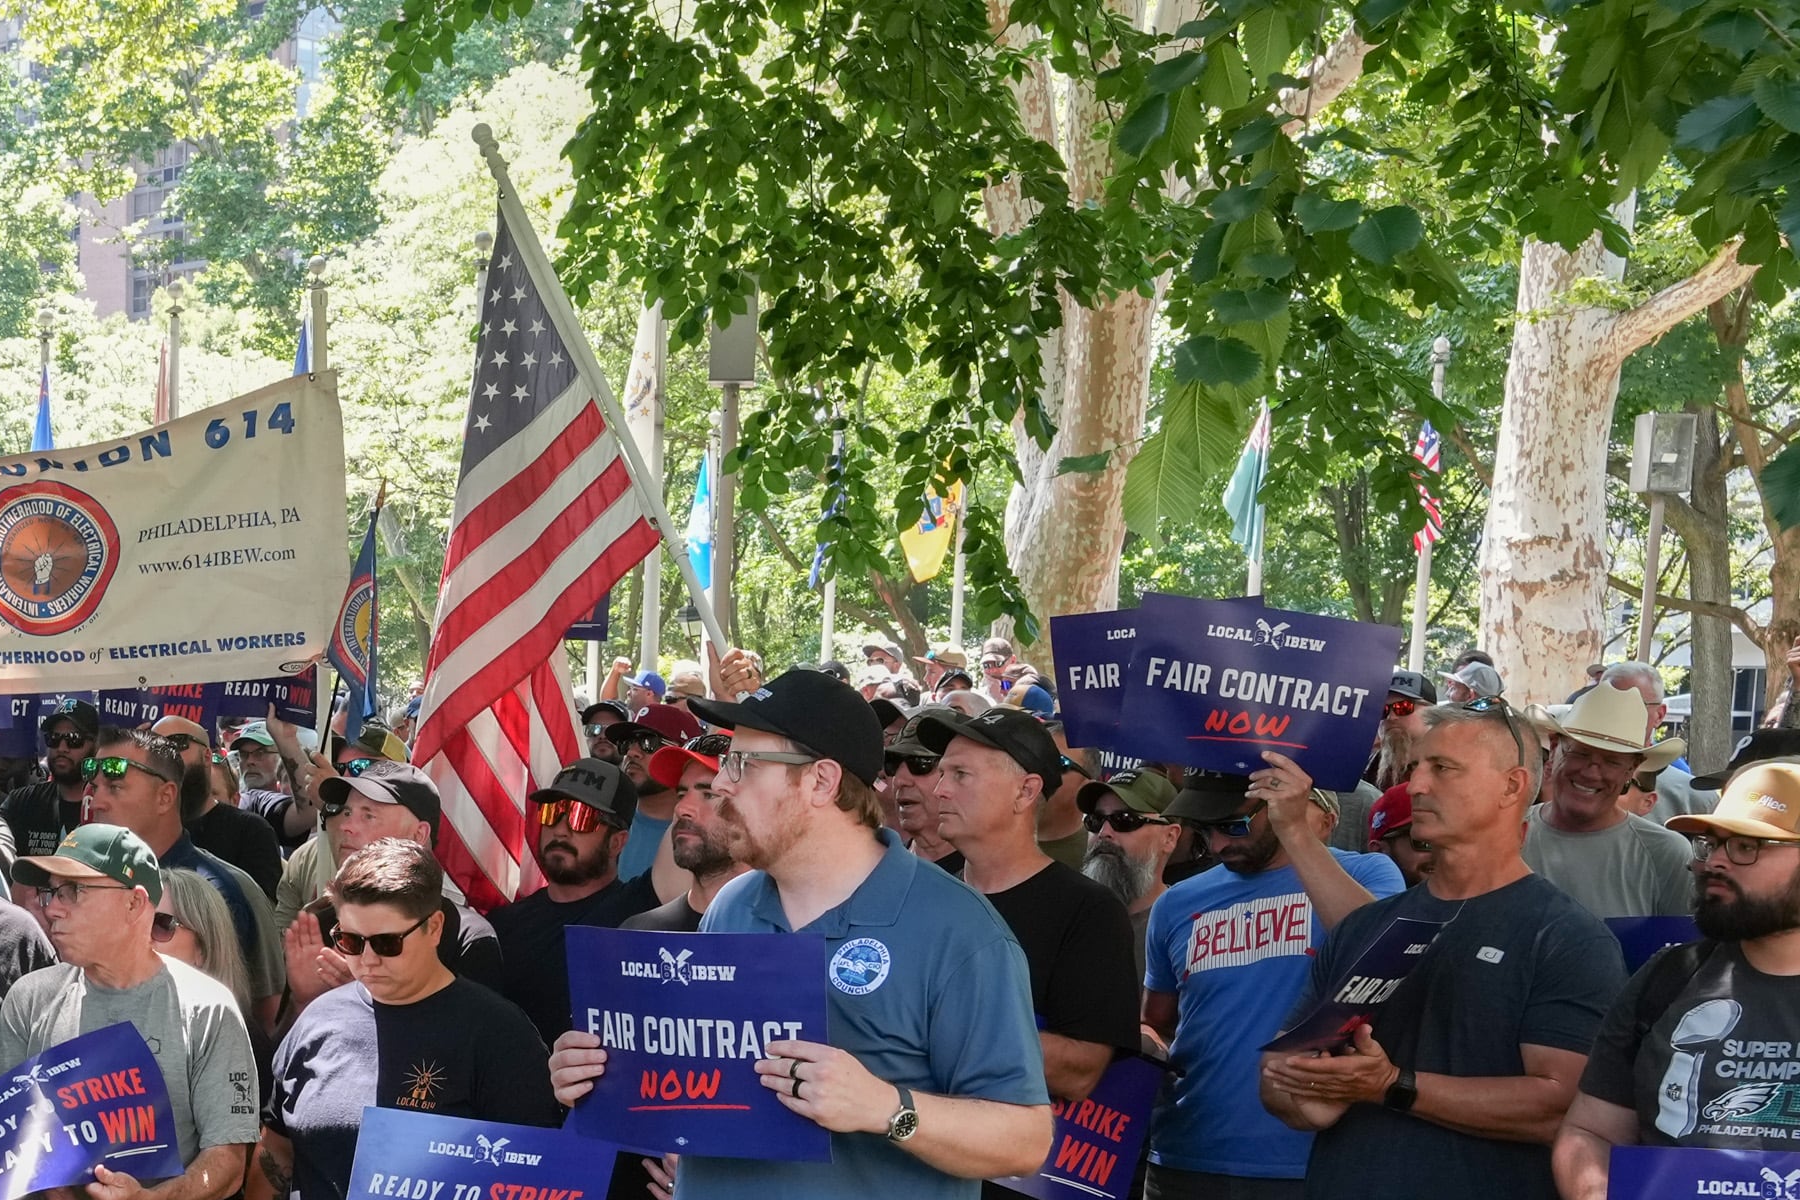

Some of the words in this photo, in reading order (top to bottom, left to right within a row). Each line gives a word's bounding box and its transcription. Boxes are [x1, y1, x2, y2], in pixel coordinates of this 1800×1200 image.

[204, 402, 295, 450] 614
[55, 503, 71, 519] OF
[137, 510, 276, 543] PHILADELPHIA,
[281, 506, 301, 524] PA
[70, 513, 101, 573] ELECTRICAL
[138, 547, 296, 575] www.614IBEW.com
[47, 575, 93, 615] WORKERS
[89, 647, 103, 665] of
[109, 640, 212, 660] ELECTRICAL
[217, 632, 306, 652] WORKERS
[1207, 624, 1254, 642] LOCAL
[1284, 637, 1326, 652] IBEW
[1069, 663, 1120, 690] FAIR
[1146, 656, 1212, 695] FAIR
[1219, 668, 1369, 719] CONTRACT
[224, 681, 271, 698] READY
[275, 684, 288, 700] TO
[289, 684, 312, 708] WIN
[105, 698, 137, 718] READY
[141, 705, 159, 721] TO
[163, 703, 204, 723] WIN
[1204, 709, 1291, 738] NOW
[837, 939, 890, 965] PHILADELPHIA
[621, 961, 660, 979] LOCAL
[692, 965, 737, 982] IBEW
[832, 976, 871, 994] COUNCIL
[1334, 975, 1375, 1004] FAIR
[587, 1007, 636, 1052] FAIR
[643, 1015, 803, 1060] CONTRACT
[1722, 1038, 1792, 1058] SUPER
[47, 1057, 82, 1078] IBEW
[57, 1067, 146, 1110] STRIKE
[640, 1068, 721, 1100] NOW
[396, 1097, 420, 1109] LOCAL
[420, 1099, 436, 1110] 614
[63, 1119, 98, 1146] TO
[98, 1104, 156, 1144] WIN
[1697, 1124, 1788, 1139] PHILADELPHIA
[428, 1141, 474, 1159] LOCAL
[504, 1153, 542, 1167] IBEW
[1054, 1134, 1118, 1187] WIN
[1697, 1179, 1761, 1197] LOCAL
